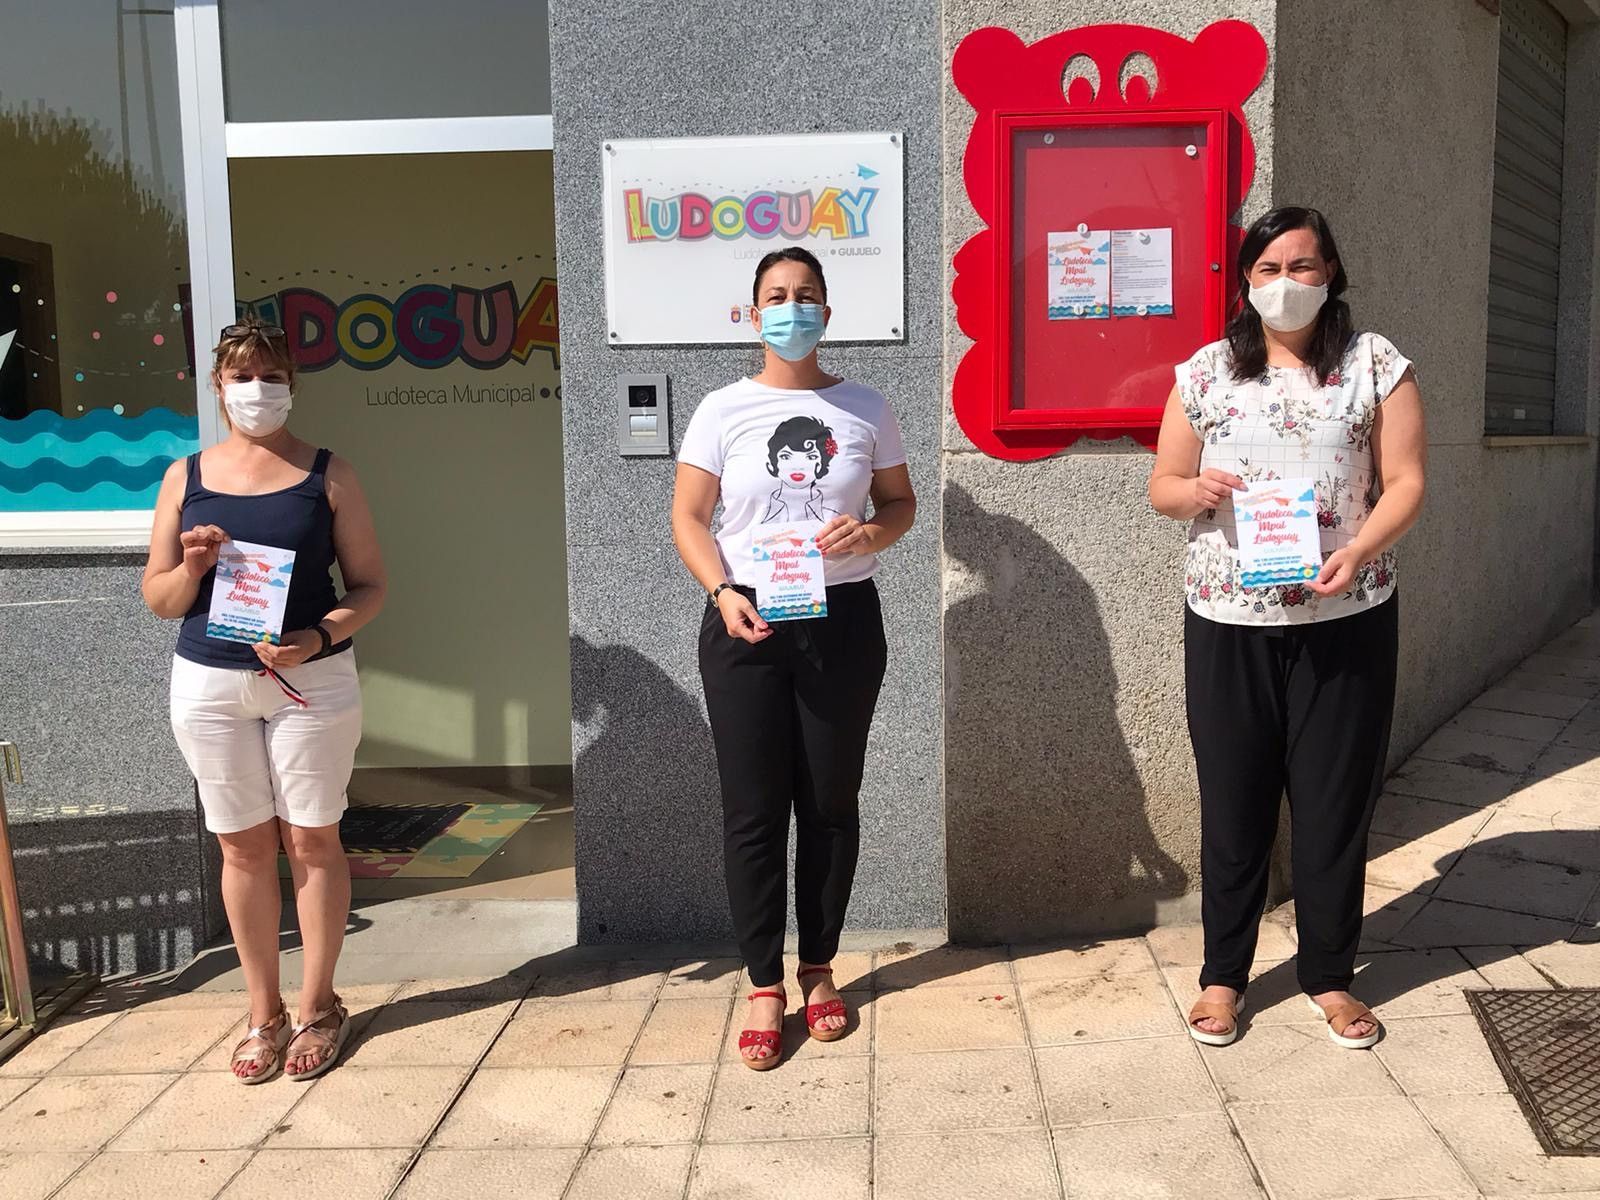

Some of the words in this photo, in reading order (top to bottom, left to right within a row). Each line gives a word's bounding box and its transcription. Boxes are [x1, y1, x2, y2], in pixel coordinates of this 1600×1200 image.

[623, 187, 879, 243] LUDOGUAY
[838, 246, 881, 257] GUIJUELO
[366, 386, 447, 407] Ludoteca
[453, 382, 535, 407] Municipal
[1253, 509, 1296, 522] Ludoteca
[1258, 520, 1287, 532] Mpal
[1253, 532, 1301, 546] Ludoguay
[770, 549, 807, 560] Ludoteca
[232, 569, 271, 584] Ludoteca
[770, 571, 812, 584] Ludoguay
[226, 590, 270, 609] Ludoguay
